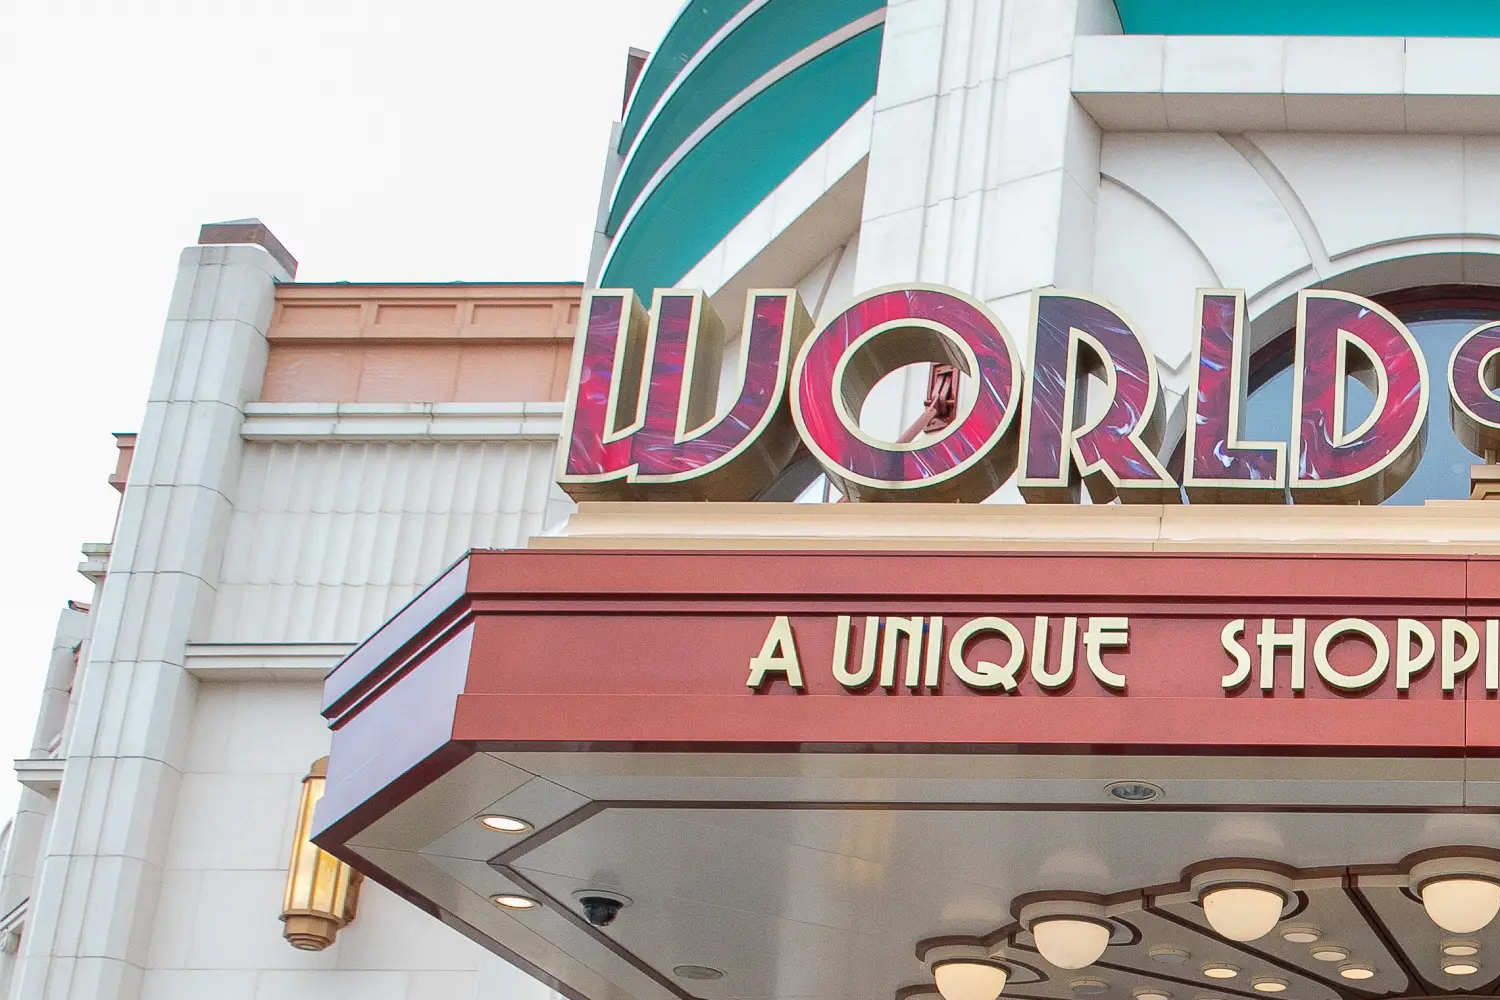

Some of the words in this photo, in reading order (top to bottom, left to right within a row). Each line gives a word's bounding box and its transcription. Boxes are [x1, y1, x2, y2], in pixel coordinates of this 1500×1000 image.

[556, 282, 1431, 492] WORLD
[746, 615, 804, 690] A
[831, 615, 1129, 693] UNIQUE
